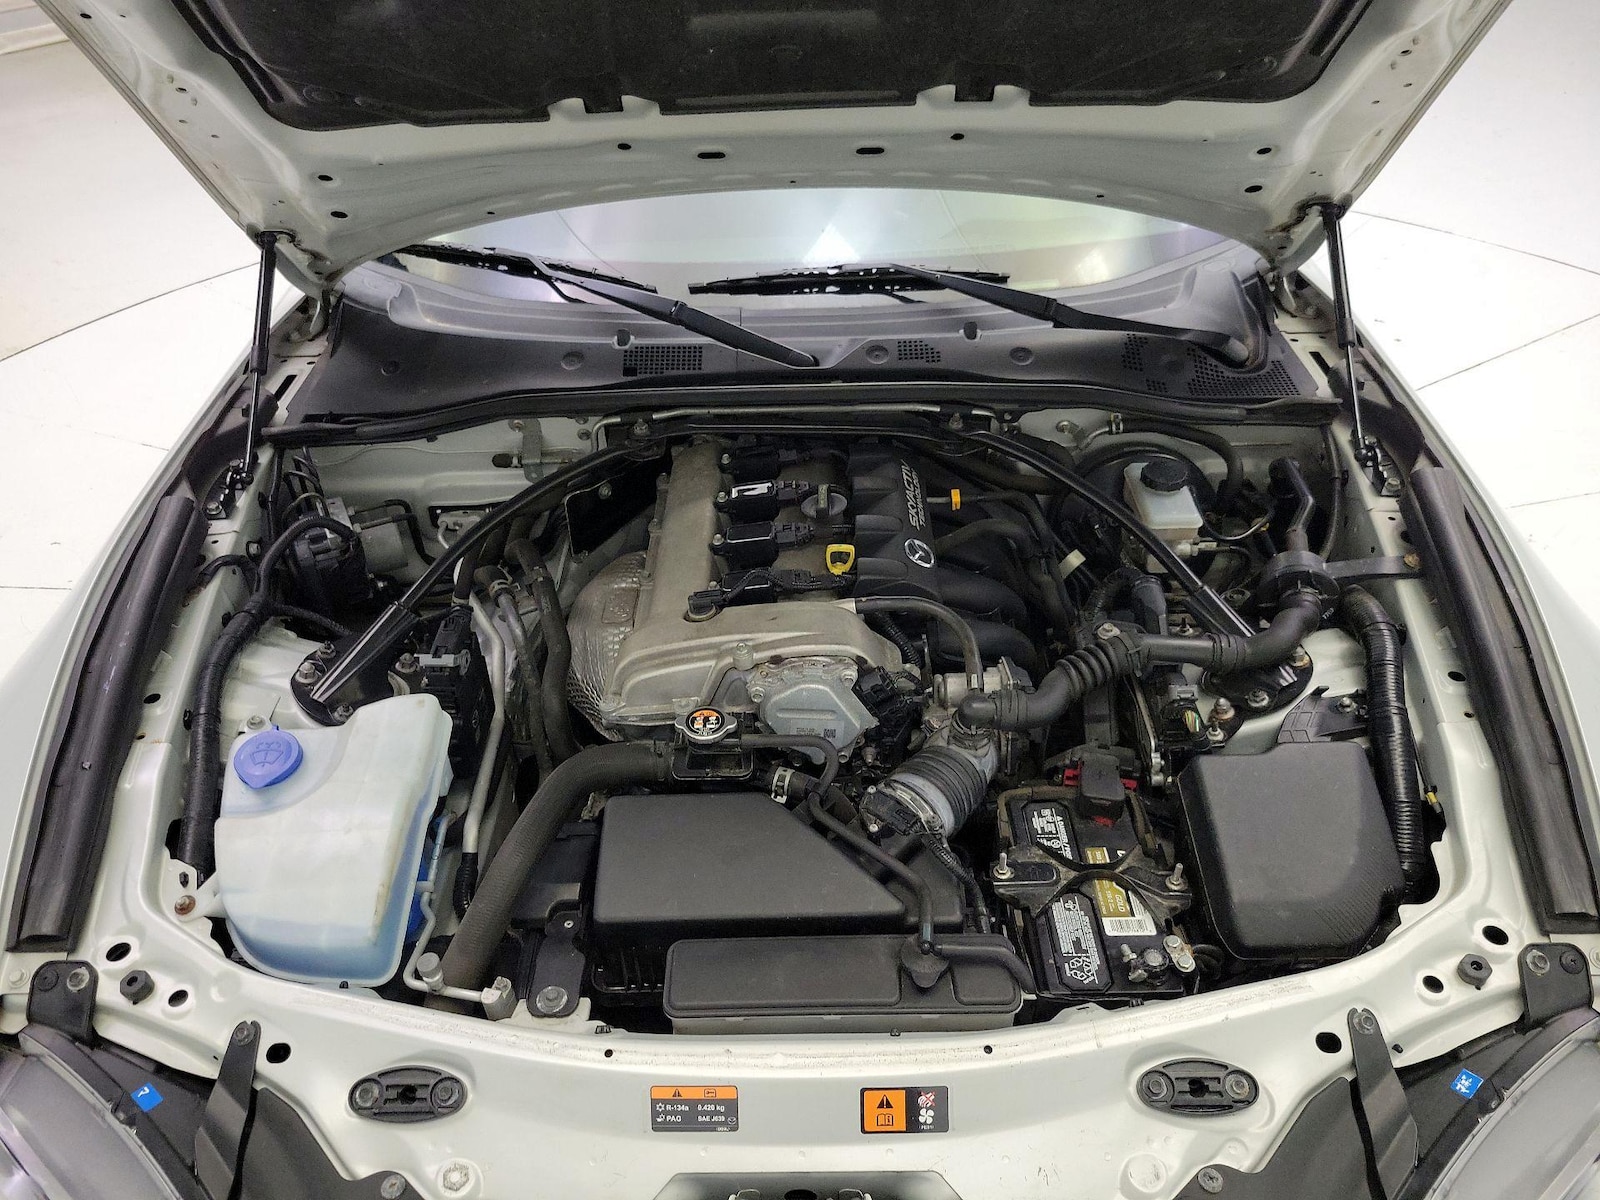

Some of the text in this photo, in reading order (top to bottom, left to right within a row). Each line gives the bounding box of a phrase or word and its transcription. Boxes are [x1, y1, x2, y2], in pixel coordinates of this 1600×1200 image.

[901, 459, 920, 531] SKYACTIV
[911, 468, 926, 527] TECHNOLOGY
[1115, 894, 1126, 912] GOLD
[716, 1104, 725, 1112] kg
